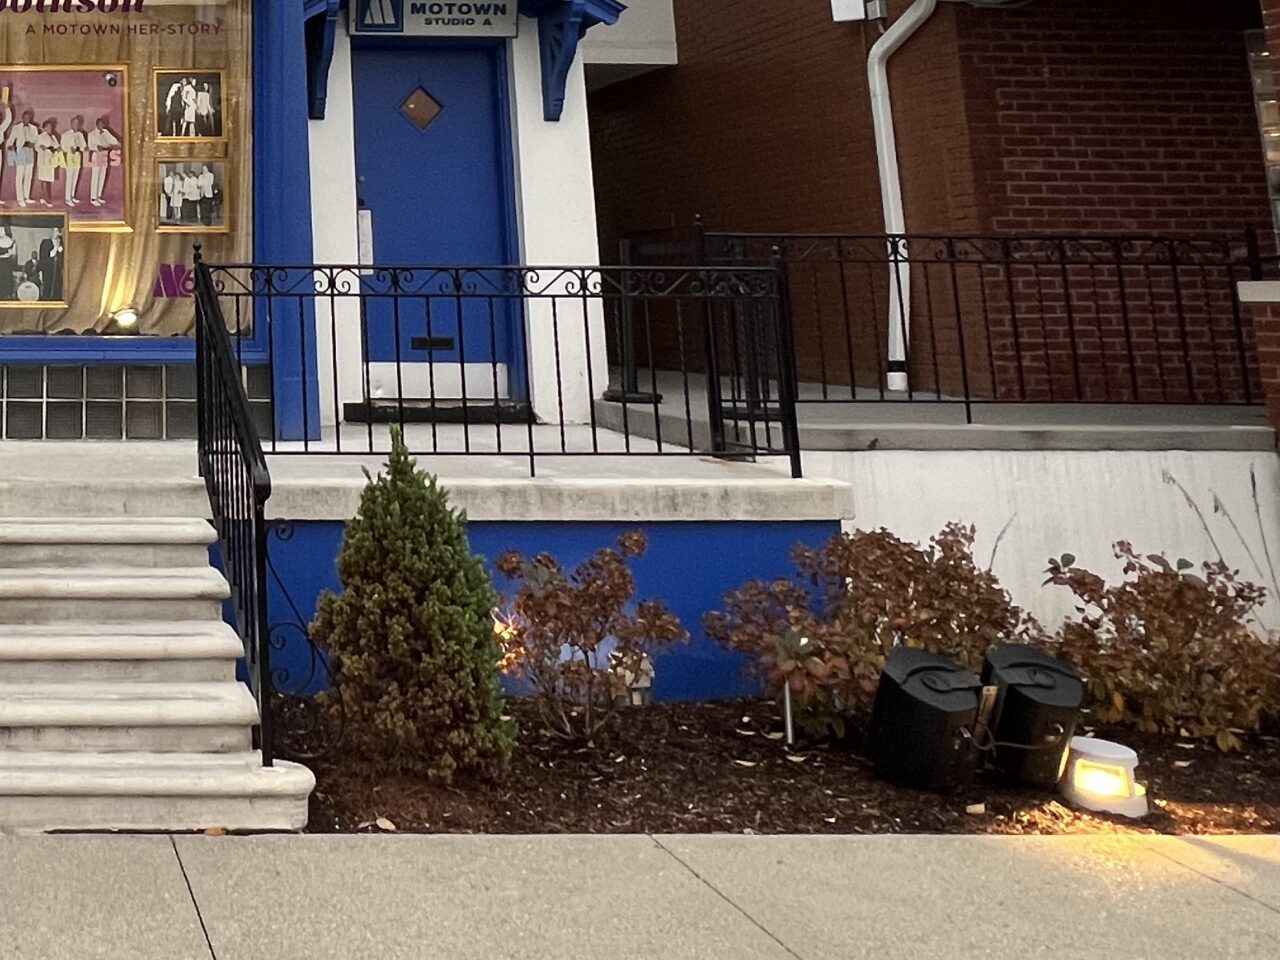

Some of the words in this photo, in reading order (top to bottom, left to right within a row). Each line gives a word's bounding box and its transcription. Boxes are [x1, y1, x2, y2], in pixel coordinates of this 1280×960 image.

[410, 2, 507, 16] MOTOWN
[424, 17, 476, 26] STUDIO
[482, 17, 493, 26] A
[25, 23, 36, 36] A
[42, 23, 121, 37] MOTOWN
[126, 24, 223, 37] HER-STORY
